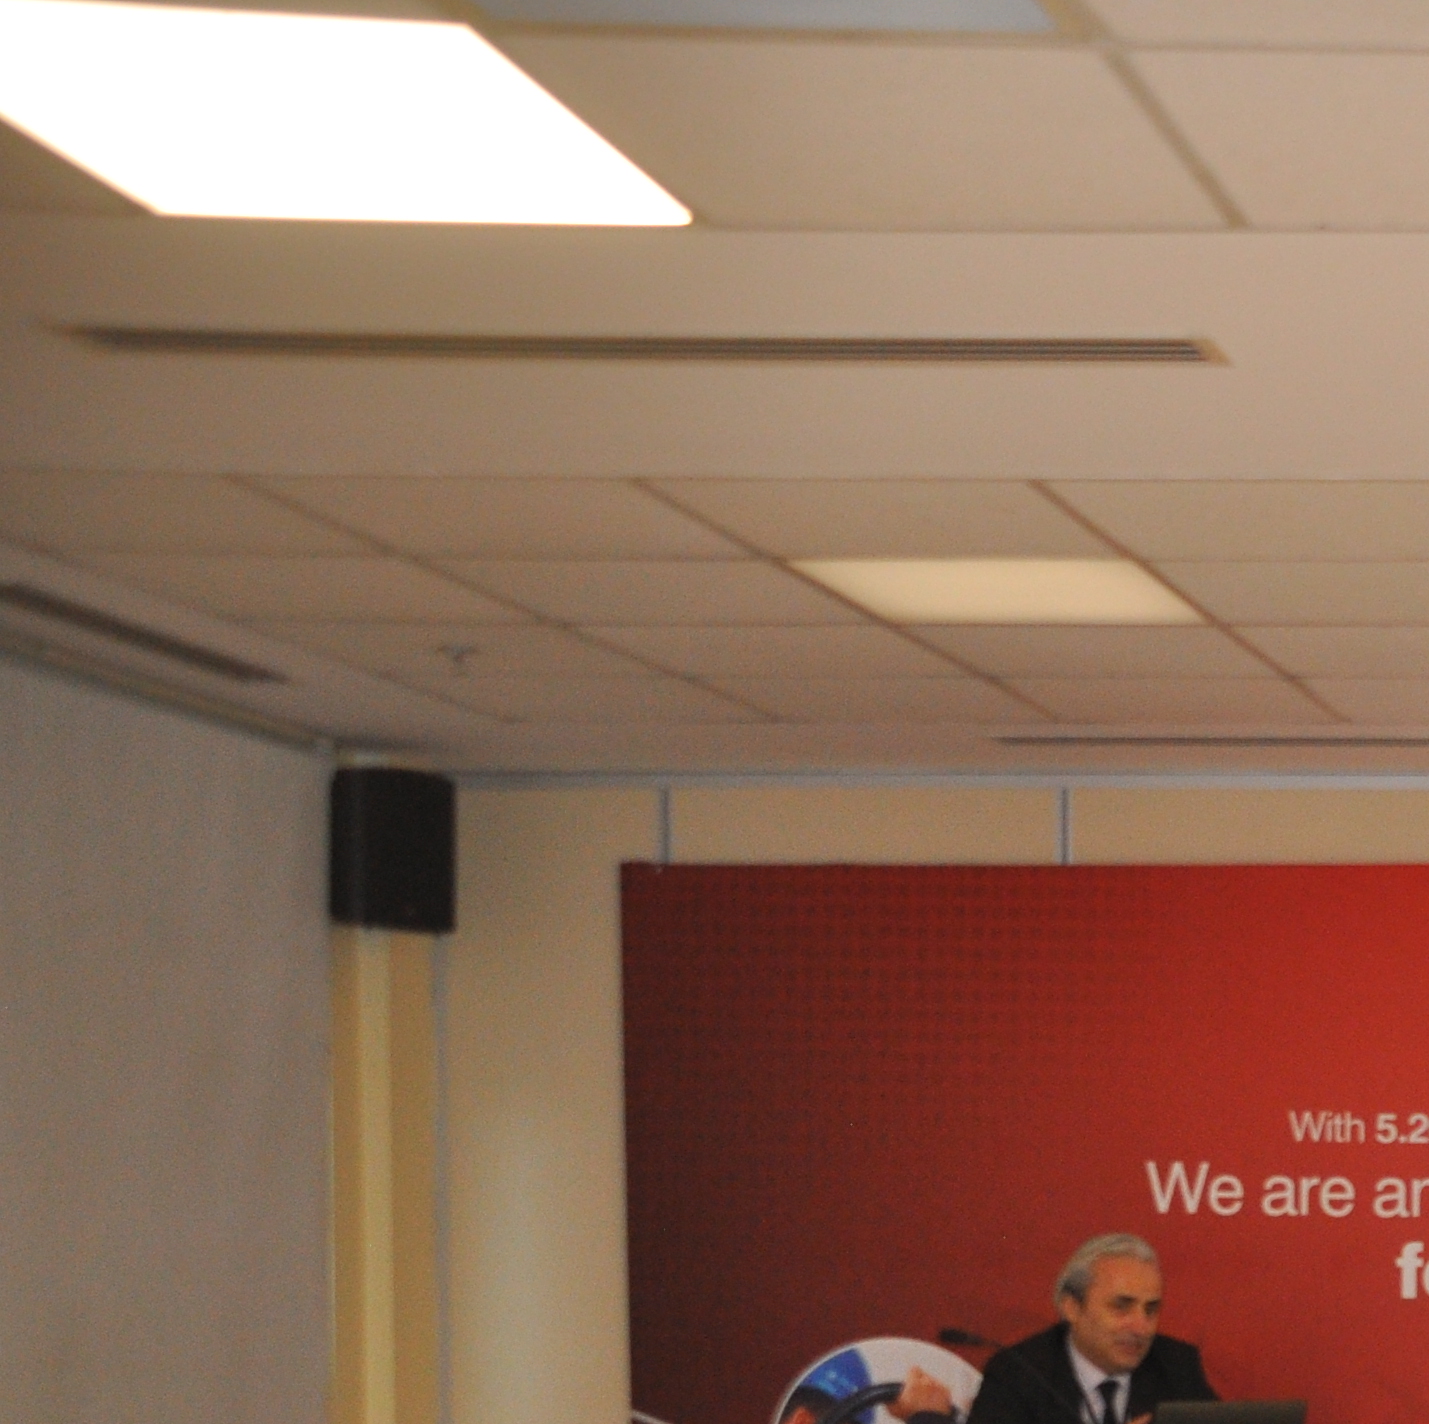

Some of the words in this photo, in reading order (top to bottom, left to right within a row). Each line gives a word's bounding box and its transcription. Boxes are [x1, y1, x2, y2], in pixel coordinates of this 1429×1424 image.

[1289, 1110, 1366, 1144] With
[1145, 1160, 1244, 1216] We
[1261, 1174, 1356, 1217] are
